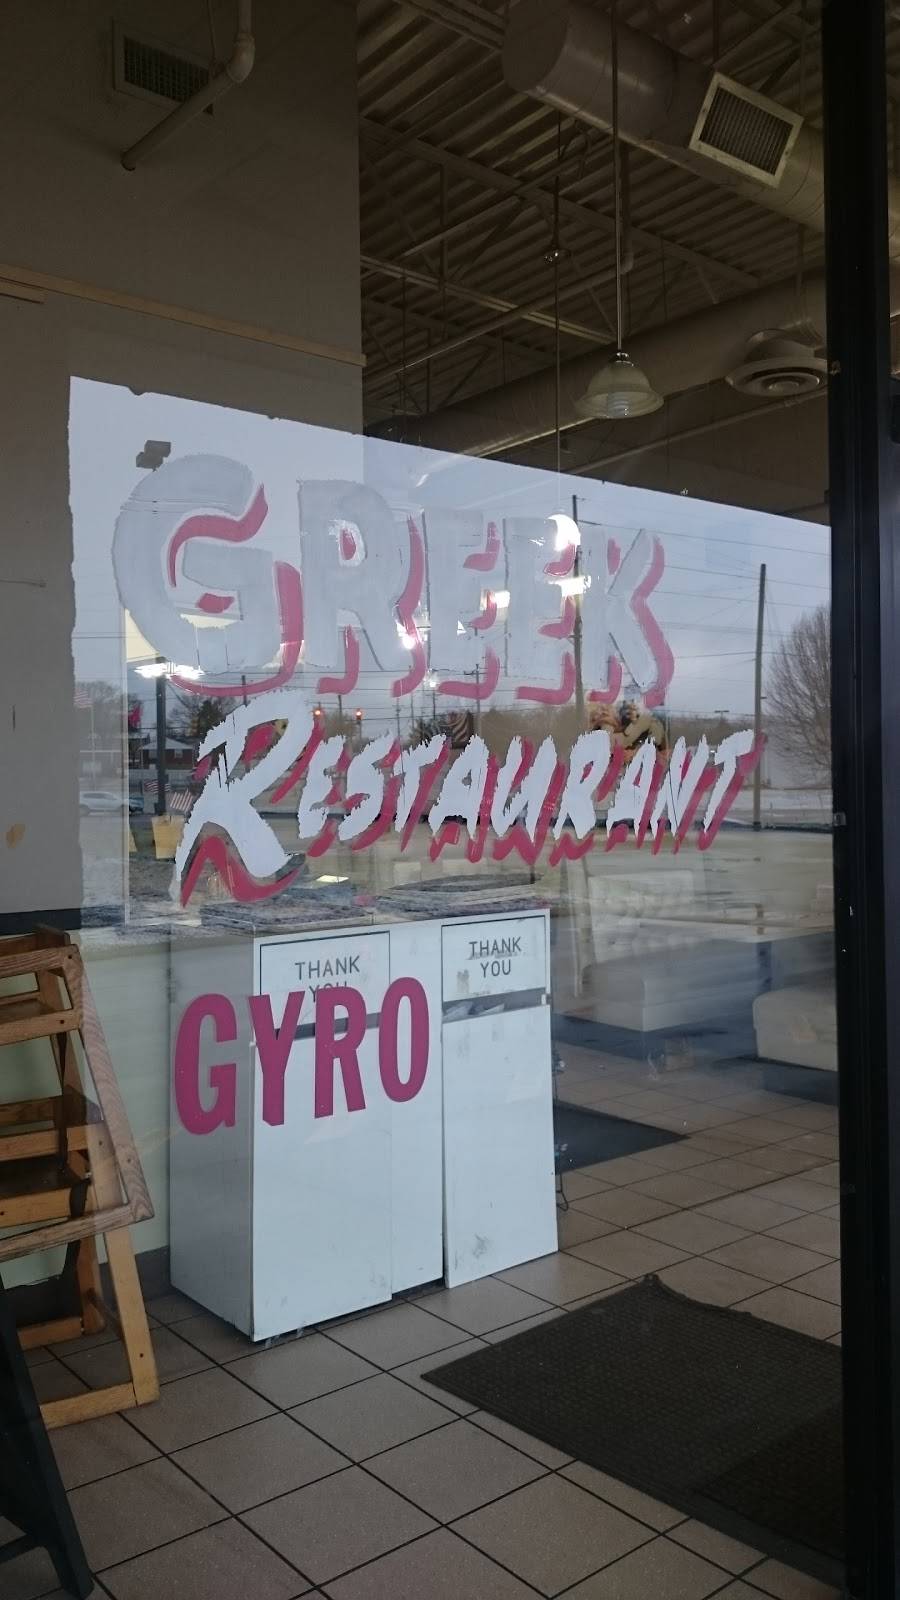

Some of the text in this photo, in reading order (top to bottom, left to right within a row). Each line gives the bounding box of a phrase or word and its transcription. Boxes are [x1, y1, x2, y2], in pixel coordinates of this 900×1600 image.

[112, 454, 676, 707] GREEK
[174, 690, 767, 906] RESTAURANT
[294, 954, 361, 980] THANK
[468, 936, 523, 958] THANK
[480, 959, 511, 978] YOU
[174, 976, 430, 1135] GYRO
